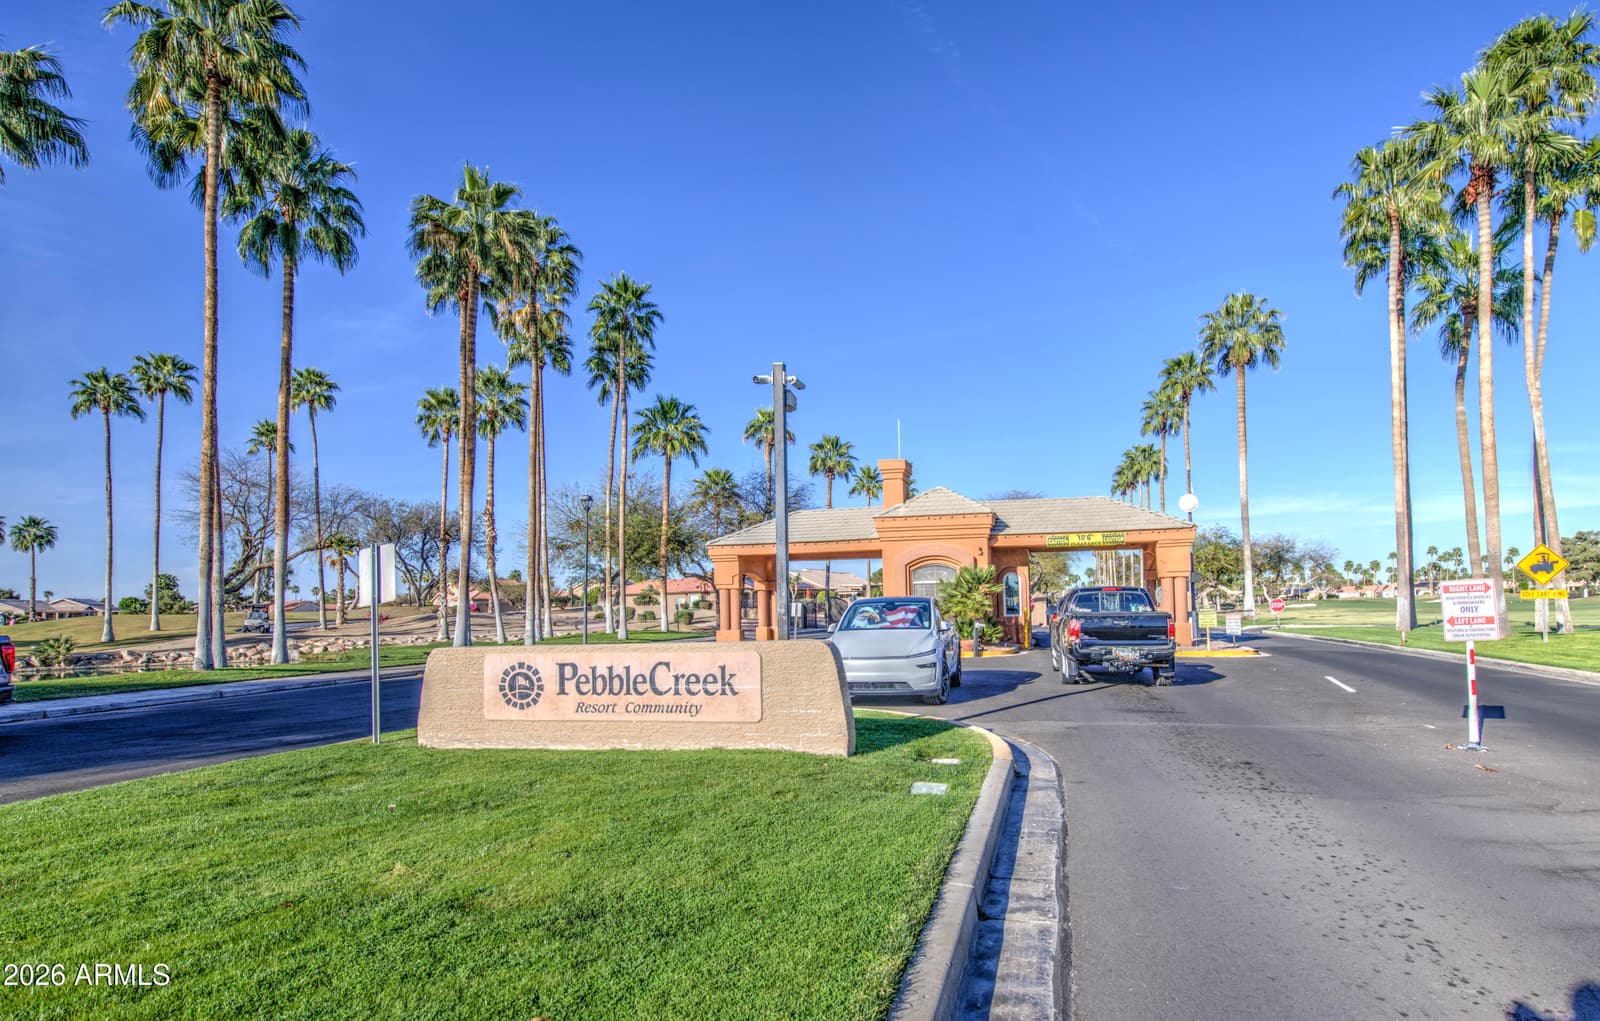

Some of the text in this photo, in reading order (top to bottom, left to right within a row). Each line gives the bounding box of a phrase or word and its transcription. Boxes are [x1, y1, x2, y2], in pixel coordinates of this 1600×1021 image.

[555, 661, 739, 697] PebbleCreek
[575, 701, 702, 717] Resort Community
